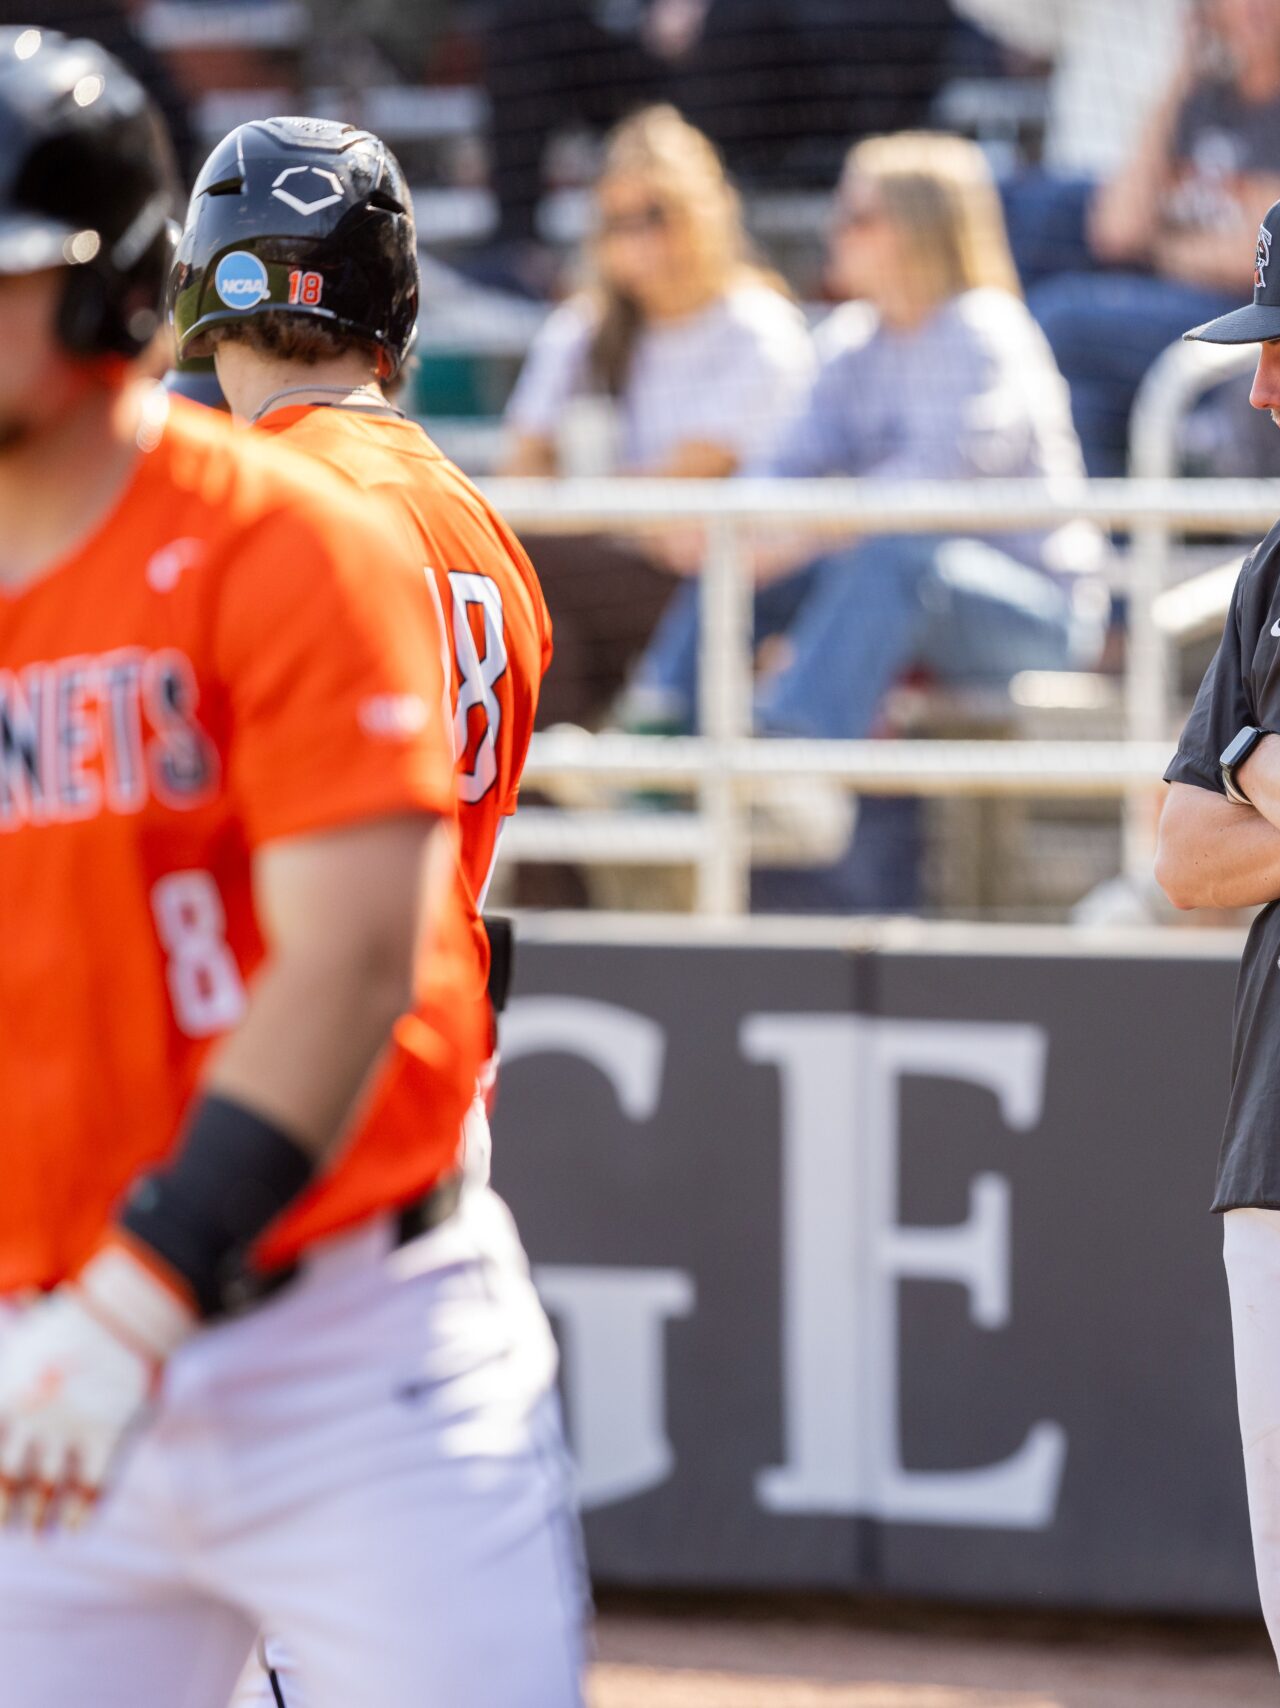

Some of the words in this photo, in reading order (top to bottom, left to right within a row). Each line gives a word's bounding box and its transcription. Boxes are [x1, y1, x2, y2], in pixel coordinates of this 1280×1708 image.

[221, 278, 263, 294] NCAA
[288, 270, 323, 305] 18
[151, 868, 247, 1036] 8
